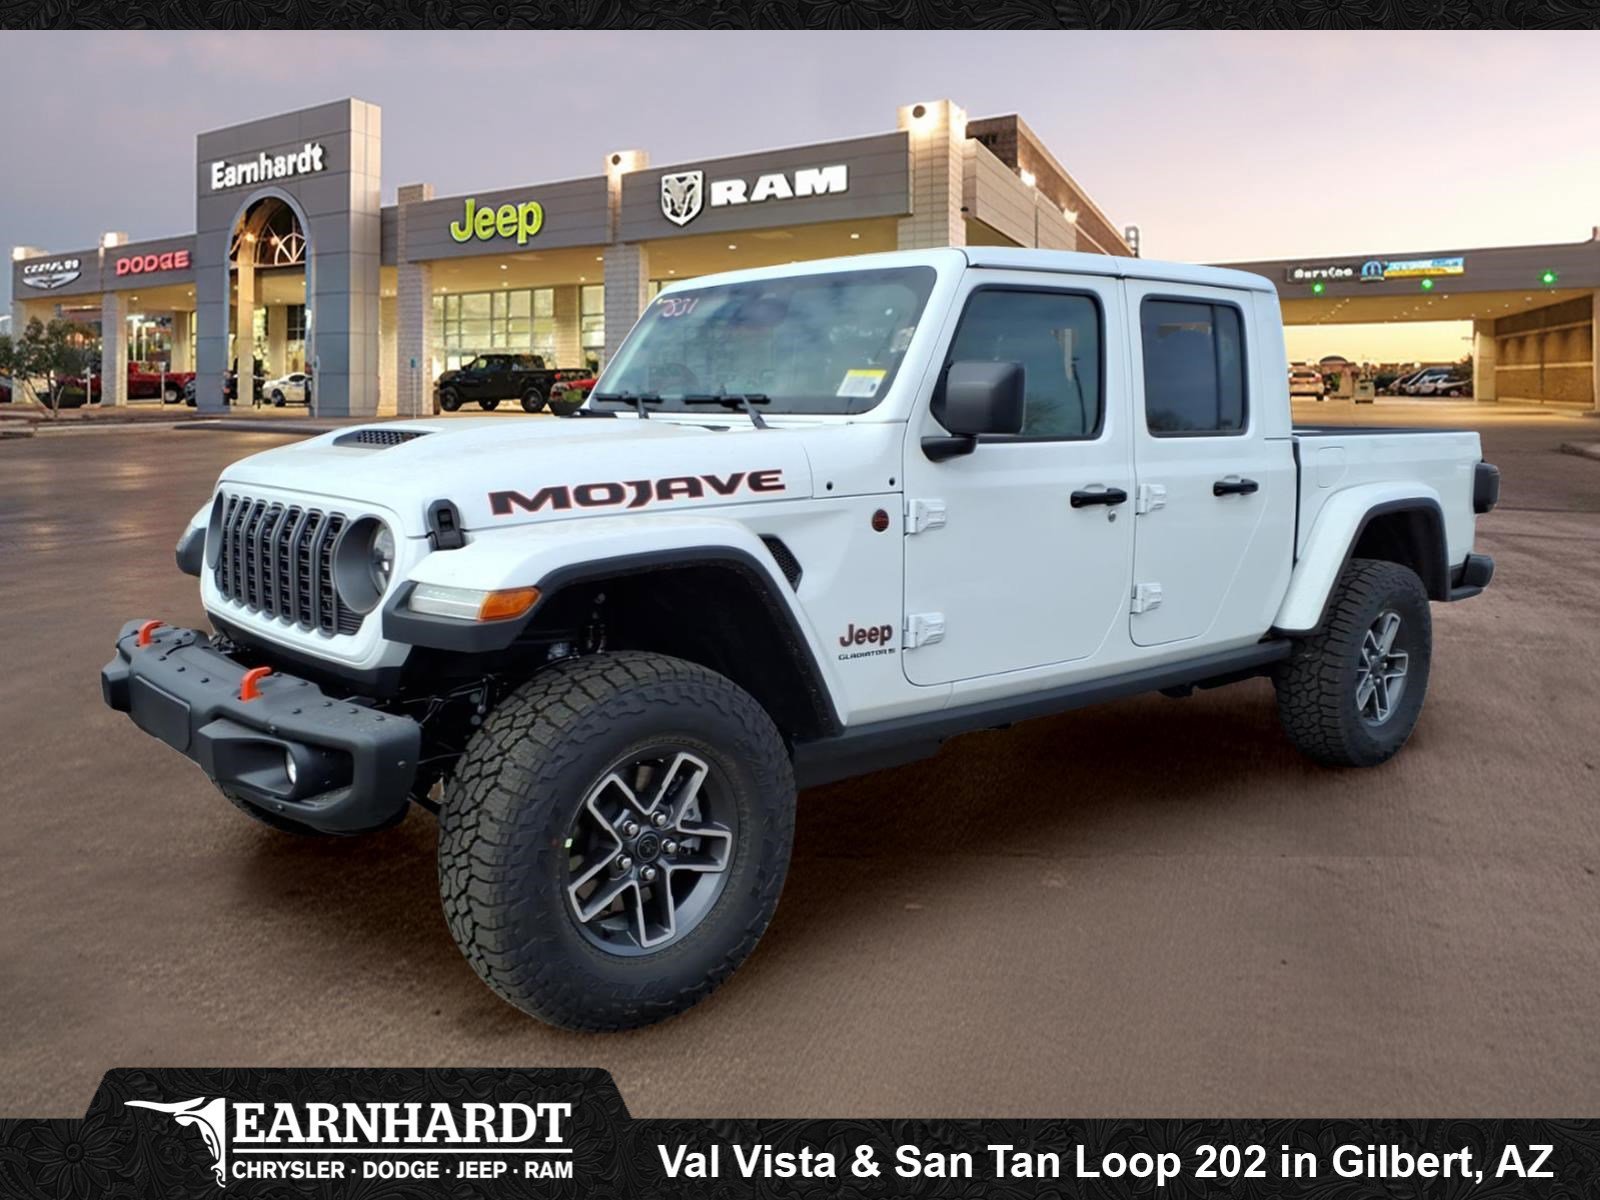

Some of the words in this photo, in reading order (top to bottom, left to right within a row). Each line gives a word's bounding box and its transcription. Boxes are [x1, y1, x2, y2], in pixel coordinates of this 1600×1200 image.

[211, 142, 324, 190] Earnhardt
[711, 164, 848, 207] RAM
[450, 198, 544, 245] Jeep
[116, 250, 190, 276] DODGE
[489, 468, 786, 516] MOJAVE
[838, 648, 887, 661] GLADIATOR
[839, 623, 894, 647] Jeep
